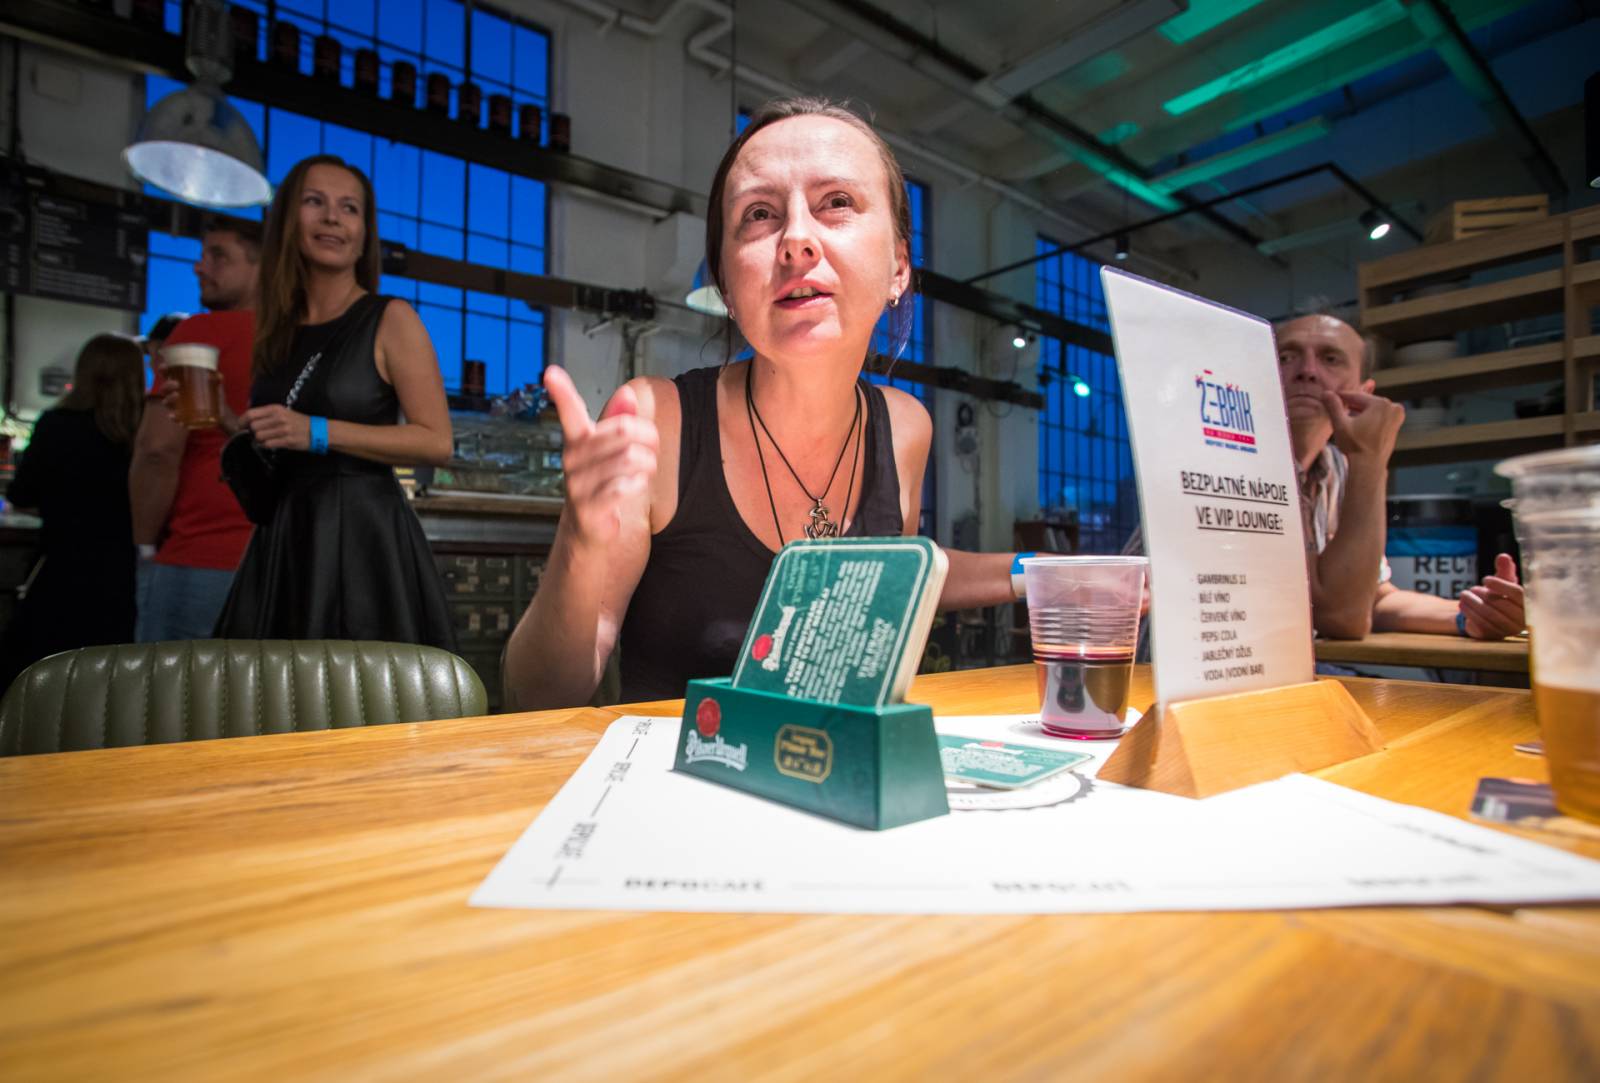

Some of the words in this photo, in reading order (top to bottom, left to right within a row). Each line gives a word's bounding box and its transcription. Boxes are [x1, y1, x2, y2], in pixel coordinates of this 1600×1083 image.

[1181, 470, 1247, 497] BEZPLATNÉ
[1248, 477, 1289, 502] NÁPOJE
[1196, 506, 1212, 525] VE
[1214, 507, 1233, 527] VIP
[1237, 510, 1284, 531] LOUNGE:
[1197, 574, 1237, 585] GAMBRINUS
[1214, 590, 1230, 603] VÍNO
[1220, 629, 1237, 641] COLA
[1203, 669, 1224, 681] VODA
